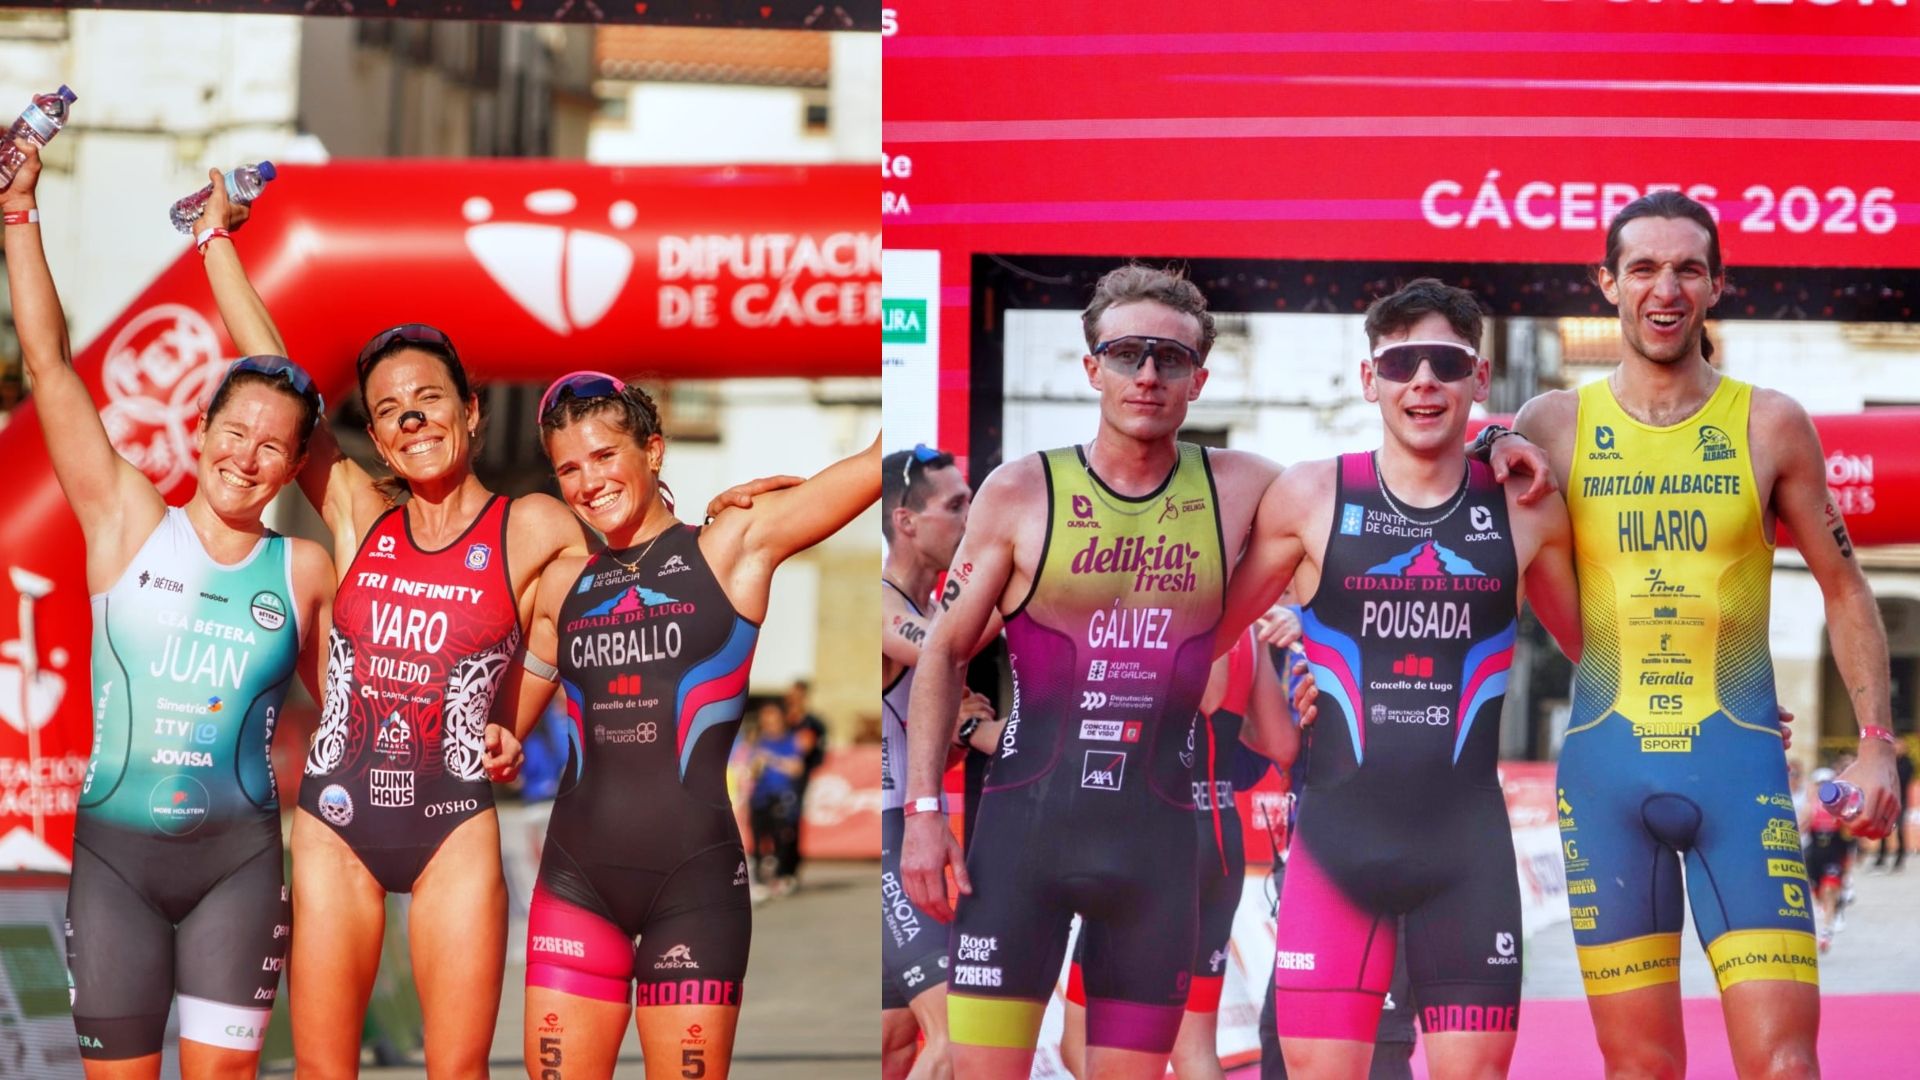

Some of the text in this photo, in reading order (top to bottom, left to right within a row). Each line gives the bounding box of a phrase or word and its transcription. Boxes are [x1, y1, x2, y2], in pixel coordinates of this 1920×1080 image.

[1421, 169, 1898, 235] CÁCERS 2026
[658, 285, 719, 328] DE
[1703, 449, 1737, 461] ALBACETE
[1583, 471, 1740, 498] TRIATLÓN ALBACETE
[1067, 520, 1101, 529] austral
[1367, 510, 1407, 526] XUNTA
[1365, 523, 1432, 538] DE GALICIA
[1465, 532, 1502, 542] austral
[1618, 509, 1708, 553] HILARIO
[1071, 534, 1185, 575] delikia
[593, 573, 640, 588] DE GALICIA
[597, 569, 623, 580] XUNTA
[1134, 561, 1197, 593] fresh
[153, 576, 184, 593] BÉTERA
[357, 573, 483, 604] TRI INFINITY
[1344, 576, 1501, 592] CIDADE DE LUGO
[567, 602, 695, 632] CIDADE DE LUGO
[1088, 598, 1173, 650] GÁLVEZ
[1362, 601, 1471, 639] POUSADA
[158, 611, 256, 645] CEA BÉTERA
[371, 600, 447, 654] VARO
[571, 622, 682, 669] CARBALLO
[151, 634, 249, 690] JUAN
[370, 656, 430, 685] TOLEDO
[1110, 662, 1140, 670] XUNTA
[1107, 670, 1157, 680] DE GALICIA
[1640, 671, 1694, 685] ferralia
[1370, 681, 1453, 692] Concello de Lugo
[157, 697, 208, 715] Simetria
[381, 691, 431, 704] CAPITAL HOME
[593, 698, 659, 711] Concello de Lugo
[1649, 694, 1683, 710] res
[154, 718, 189, 737] ITV
[265, 706, 275, 740] CEA
[1084, 723, 1120, 731] CONCELLO
[1396, 716, 1425, 724] LUGO
[378, 727, 410, 743] ACP
[613, 734, 636, 743] LUGO
[376, 741, 409, 750] FINANCE
[1643, 739, 1688, 750] SPORT
[152, 750, 213, 767] JOVISA
[83, 760, 98, 794] CEA
[371, 770, 412, 788] WINK
[1083, 770, 1114, 786] AXA
[372, 788, 413, 806] HAUS
[425, 799, 477, 818] OYSHO
[533, 936, 585, 958] 226ERS
[960, 935, 997, 951] Root
[955, 966, 1002, 987] 226ERS
[636, 980, 734, 1007] CIDADE
[1424, 1005, 1515, 1032] CIDADE
[225, 1025, 254, 1038] CEA
[682, 1050, 705, 1079] 5
